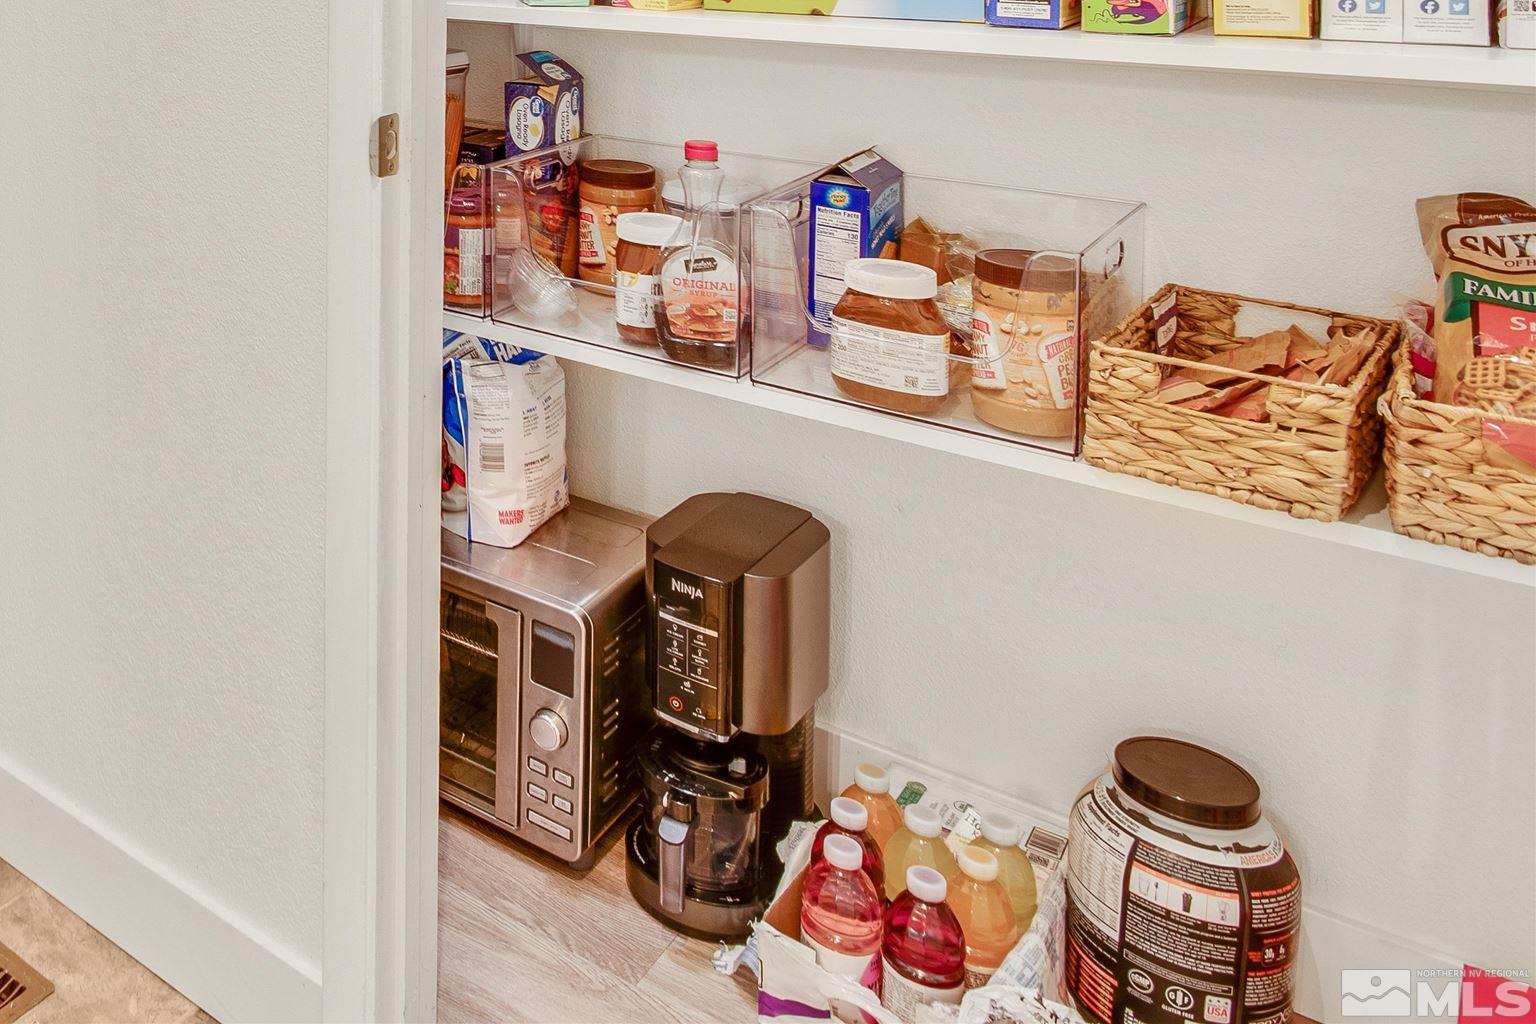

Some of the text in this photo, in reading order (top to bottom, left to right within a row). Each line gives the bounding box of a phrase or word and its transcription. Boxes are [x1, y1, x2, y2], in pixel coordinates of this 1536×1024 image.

[818, 207, 859, 219] Nutrition Facts
[1460, 233, 1536, 260] SNY
[1504, 259, 1523, 267] OF
[673, 277, 736, 291] ORIGINAL
[498, 509, 524, 517] MAKERS
[671, 577, 703, 599] NINJA
[1104, 823, 1120, 838] Facts
[1161, 1004, 1194, 1019] GLUTEN FREE
[1207, 1006, 1228, 1018] USA
